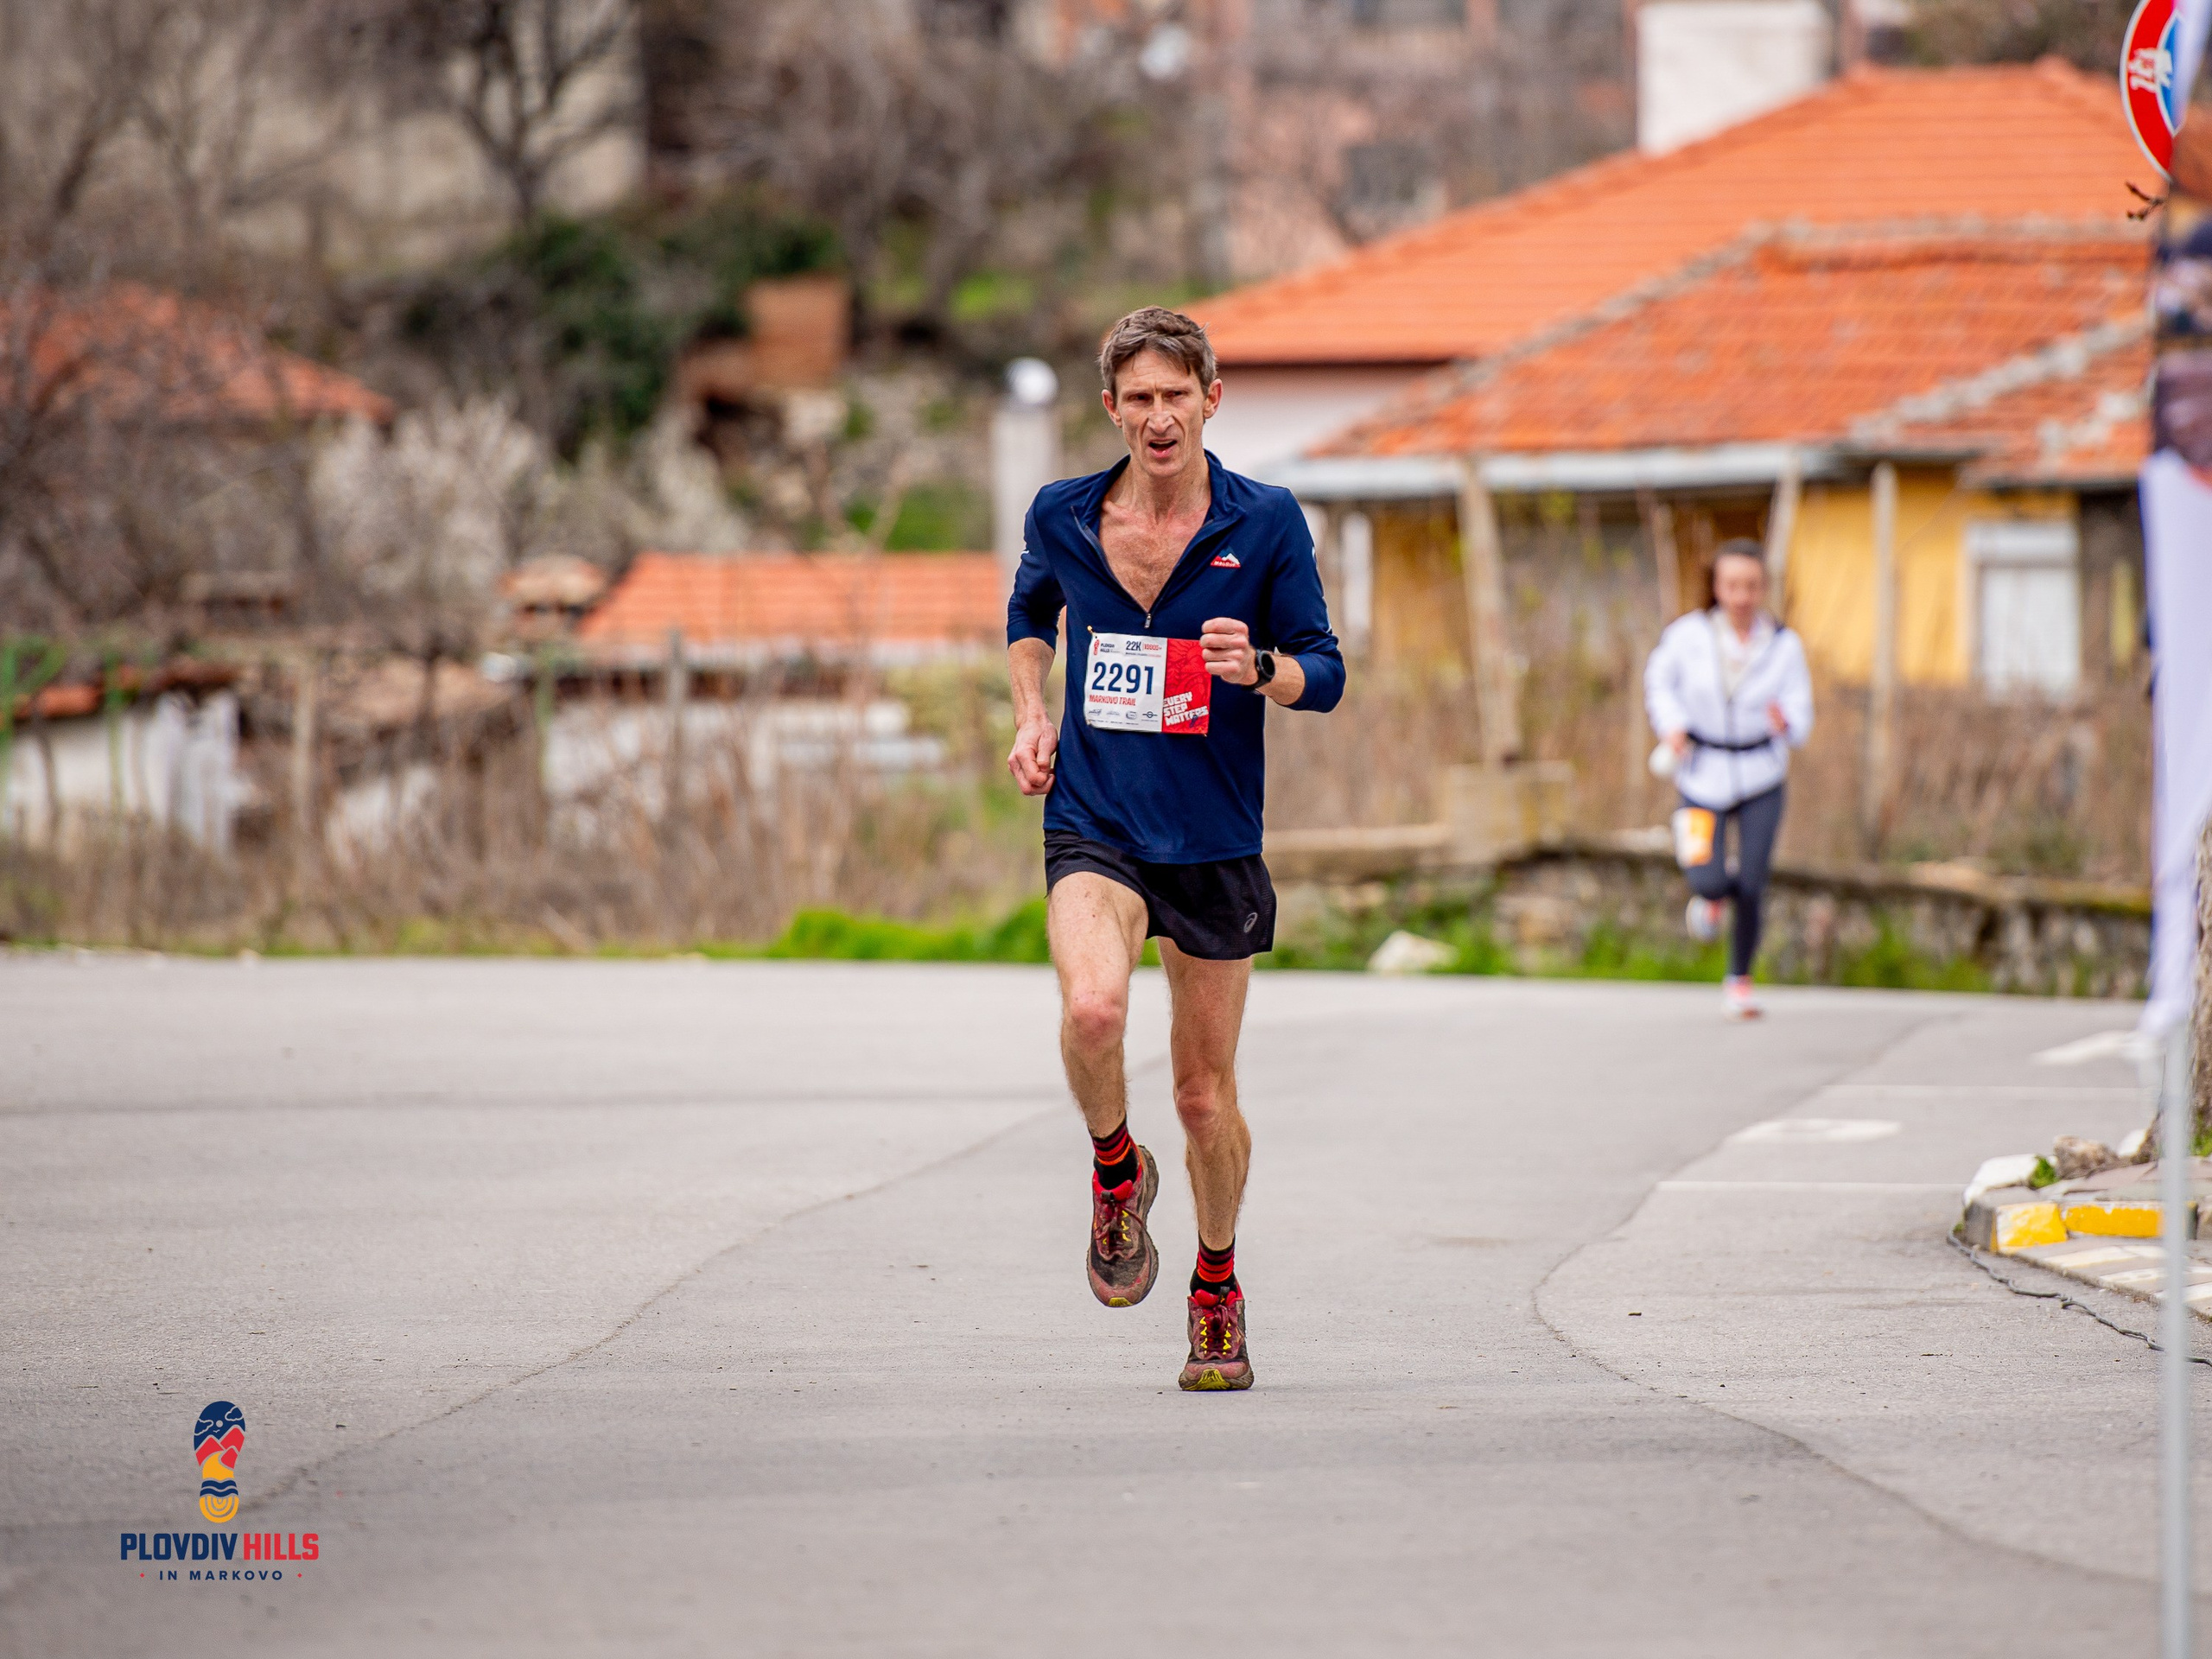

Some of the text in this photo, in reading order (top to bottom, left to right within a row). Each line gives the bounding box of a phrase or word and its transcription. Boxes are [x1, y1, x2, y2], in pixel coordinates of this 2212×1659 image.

[1126, 640, 1141, 651] 22K
[1091, 661, 1154, 695] 2291
[1089, 695, 1136, 706] MARKOVO TRAIL
[1163, 691, 1193, 708] EVERY
[1164, 702, 1189, 717] STEP
[1165, 705, 1209, 727] MATTERS
